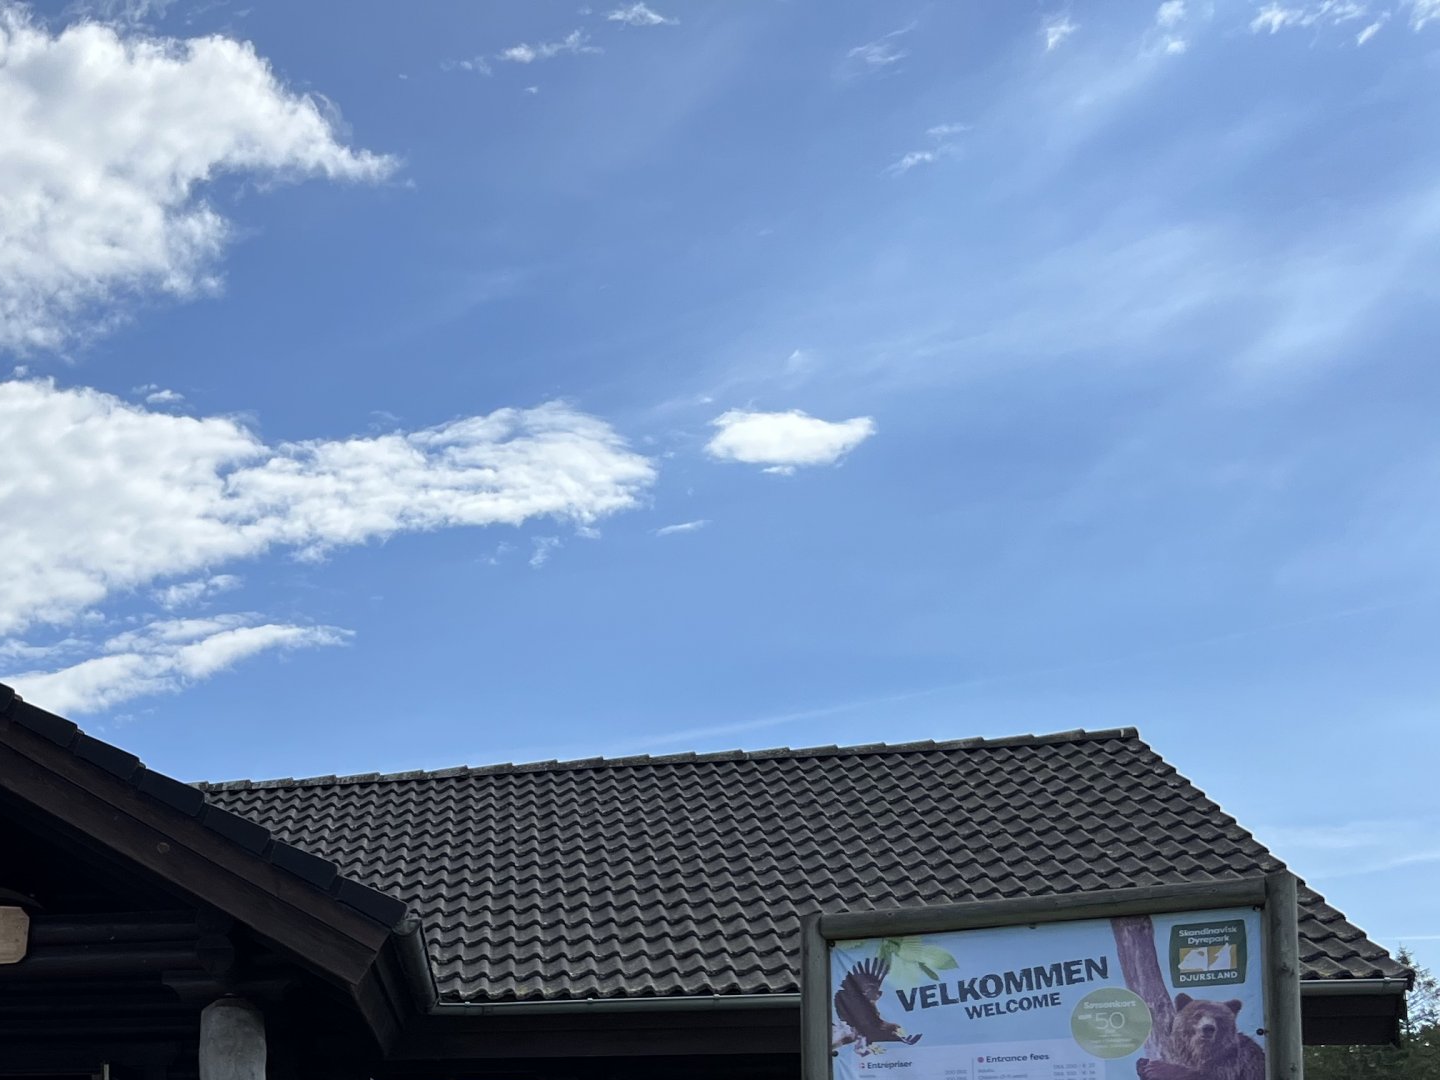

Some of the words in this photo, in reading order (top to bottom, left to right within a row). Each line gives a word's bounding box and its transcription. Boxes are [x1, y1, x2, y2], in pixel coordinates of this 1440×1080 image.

[1178, 926, 1238, 937] Skandinavisk
[1187, 935, 1230, 945] Dyrepark
[1179, 971, 1238, 982] DJURSLAND
[896, 956, 1109, 1012] VELKOMMEN
[964, 992, 1062, 1020] WELCOME
[1095, 1011, 1125, 1030] 50
[867, 1060, 912, 1069] Entrepriser
[985, 1055, 1027, 1063] Entrance
